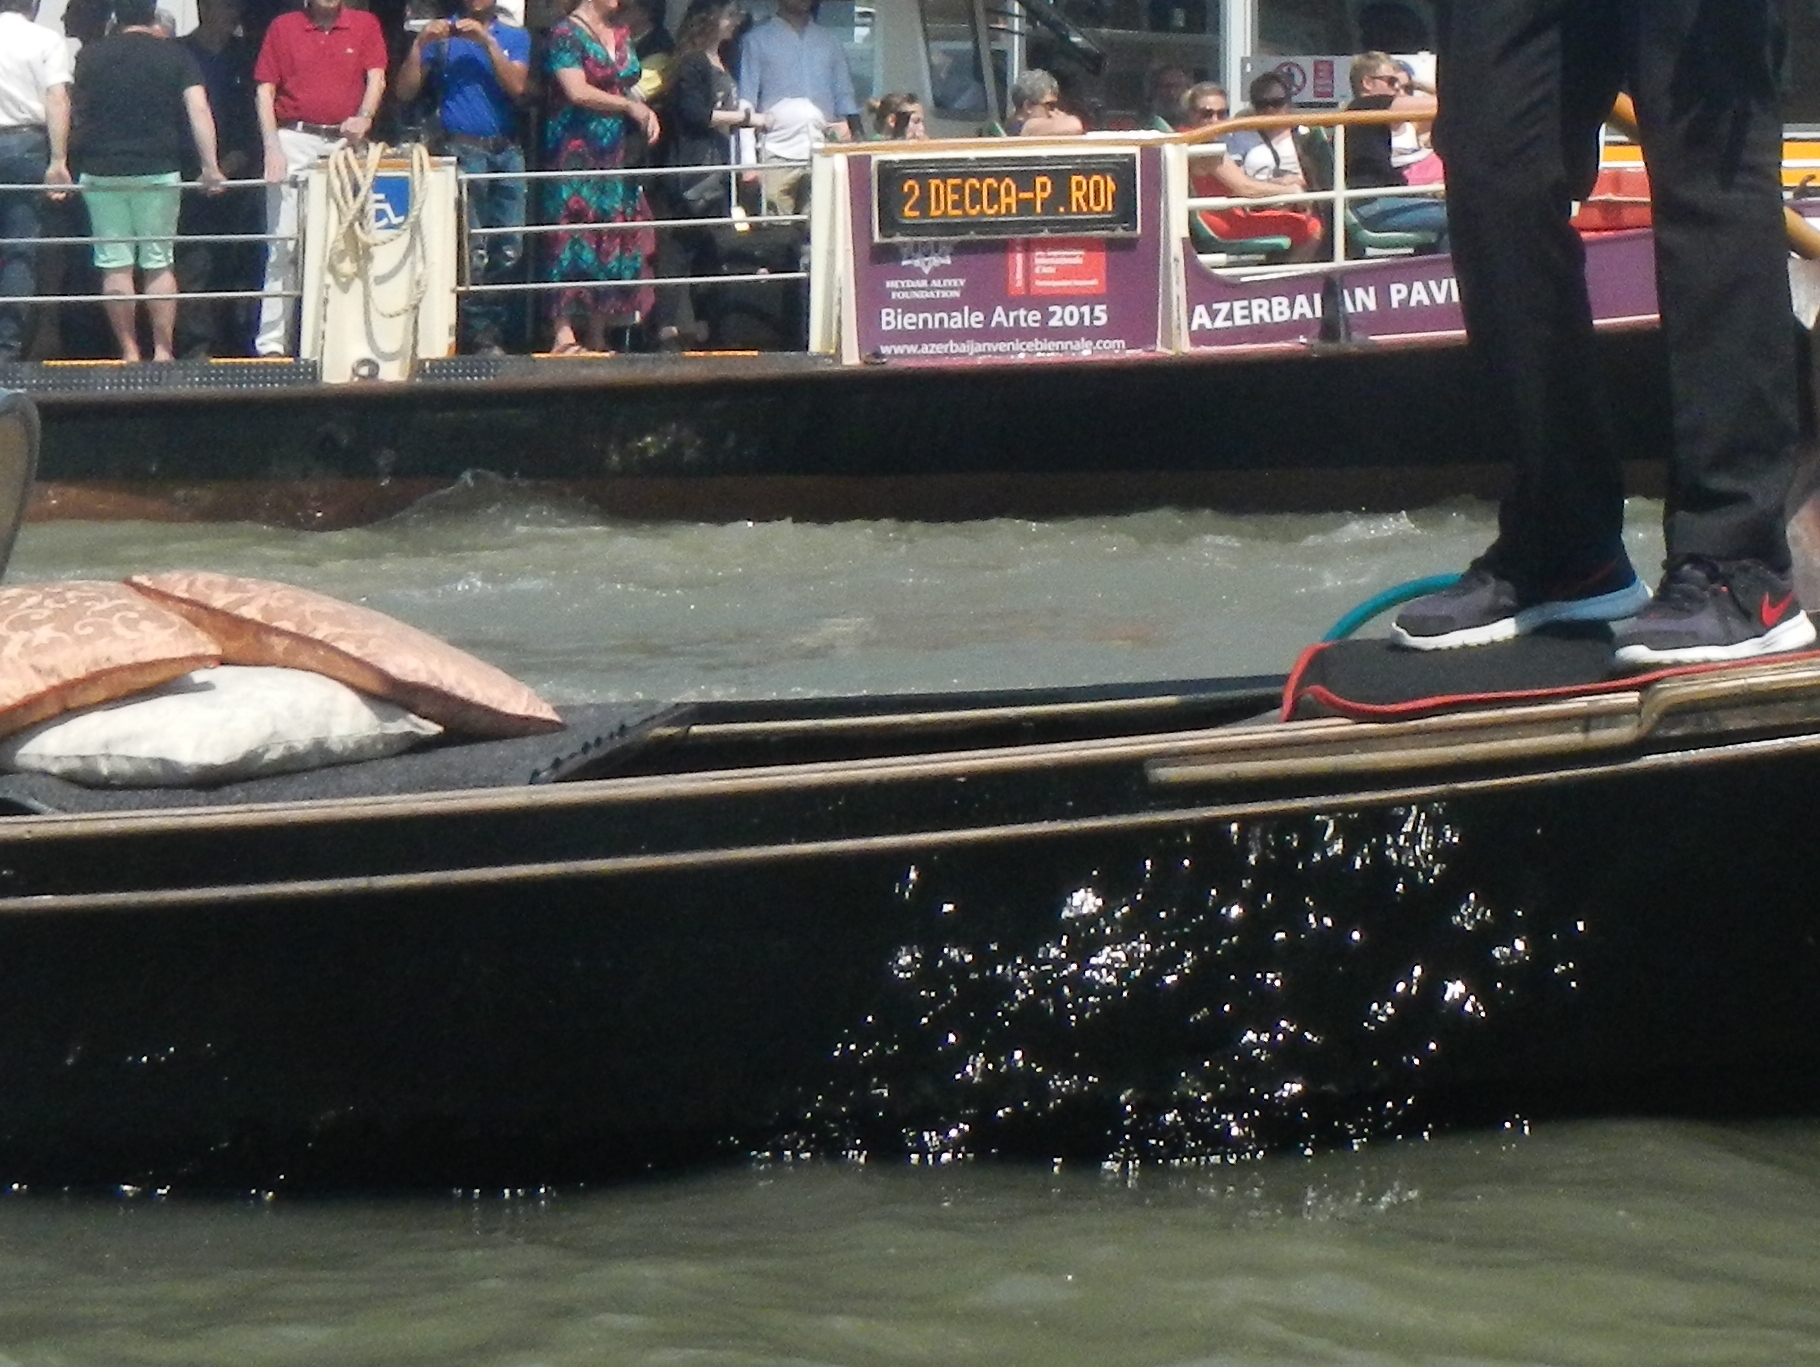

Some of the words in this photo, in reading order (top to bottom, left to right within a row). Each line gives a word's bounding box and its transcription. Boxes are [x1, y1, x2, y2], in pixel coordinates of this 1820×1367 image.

[903, 179, 921, 217] 2
[891, 290, 961, 300] FOUNDATION
[881, 306, 984, 331] Biennale
[990, 306, 1042, 329] Arte
[1048, 304, 1109, 327] 2015
[880, 337, 1127, 356] www.azerbaijanvenicebiennale.com
